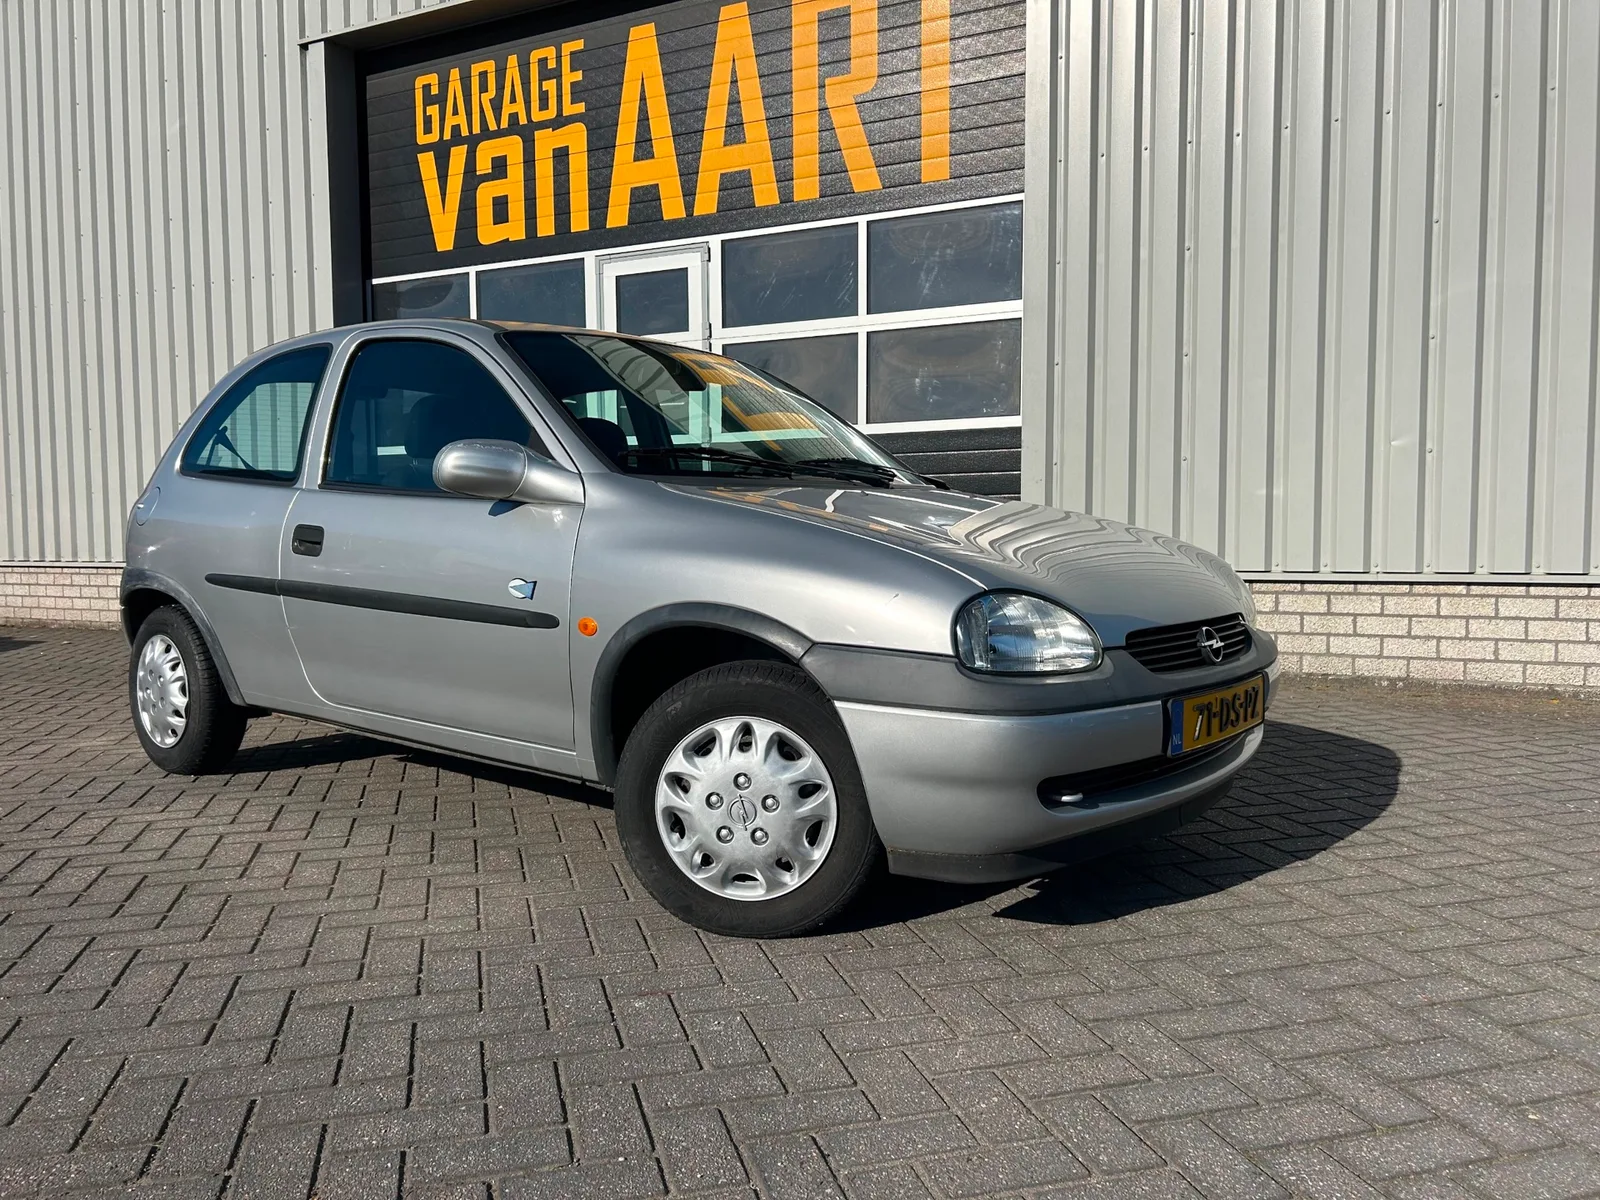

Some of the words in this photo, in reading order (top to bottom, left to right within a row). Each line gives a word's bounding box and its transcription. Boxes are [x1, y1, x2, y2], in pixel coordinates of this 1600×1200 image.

[414, 39, 586, 145] GARAGE
[416, 121, 590, 252] van
[1172, 733, 1182, 746] NL
